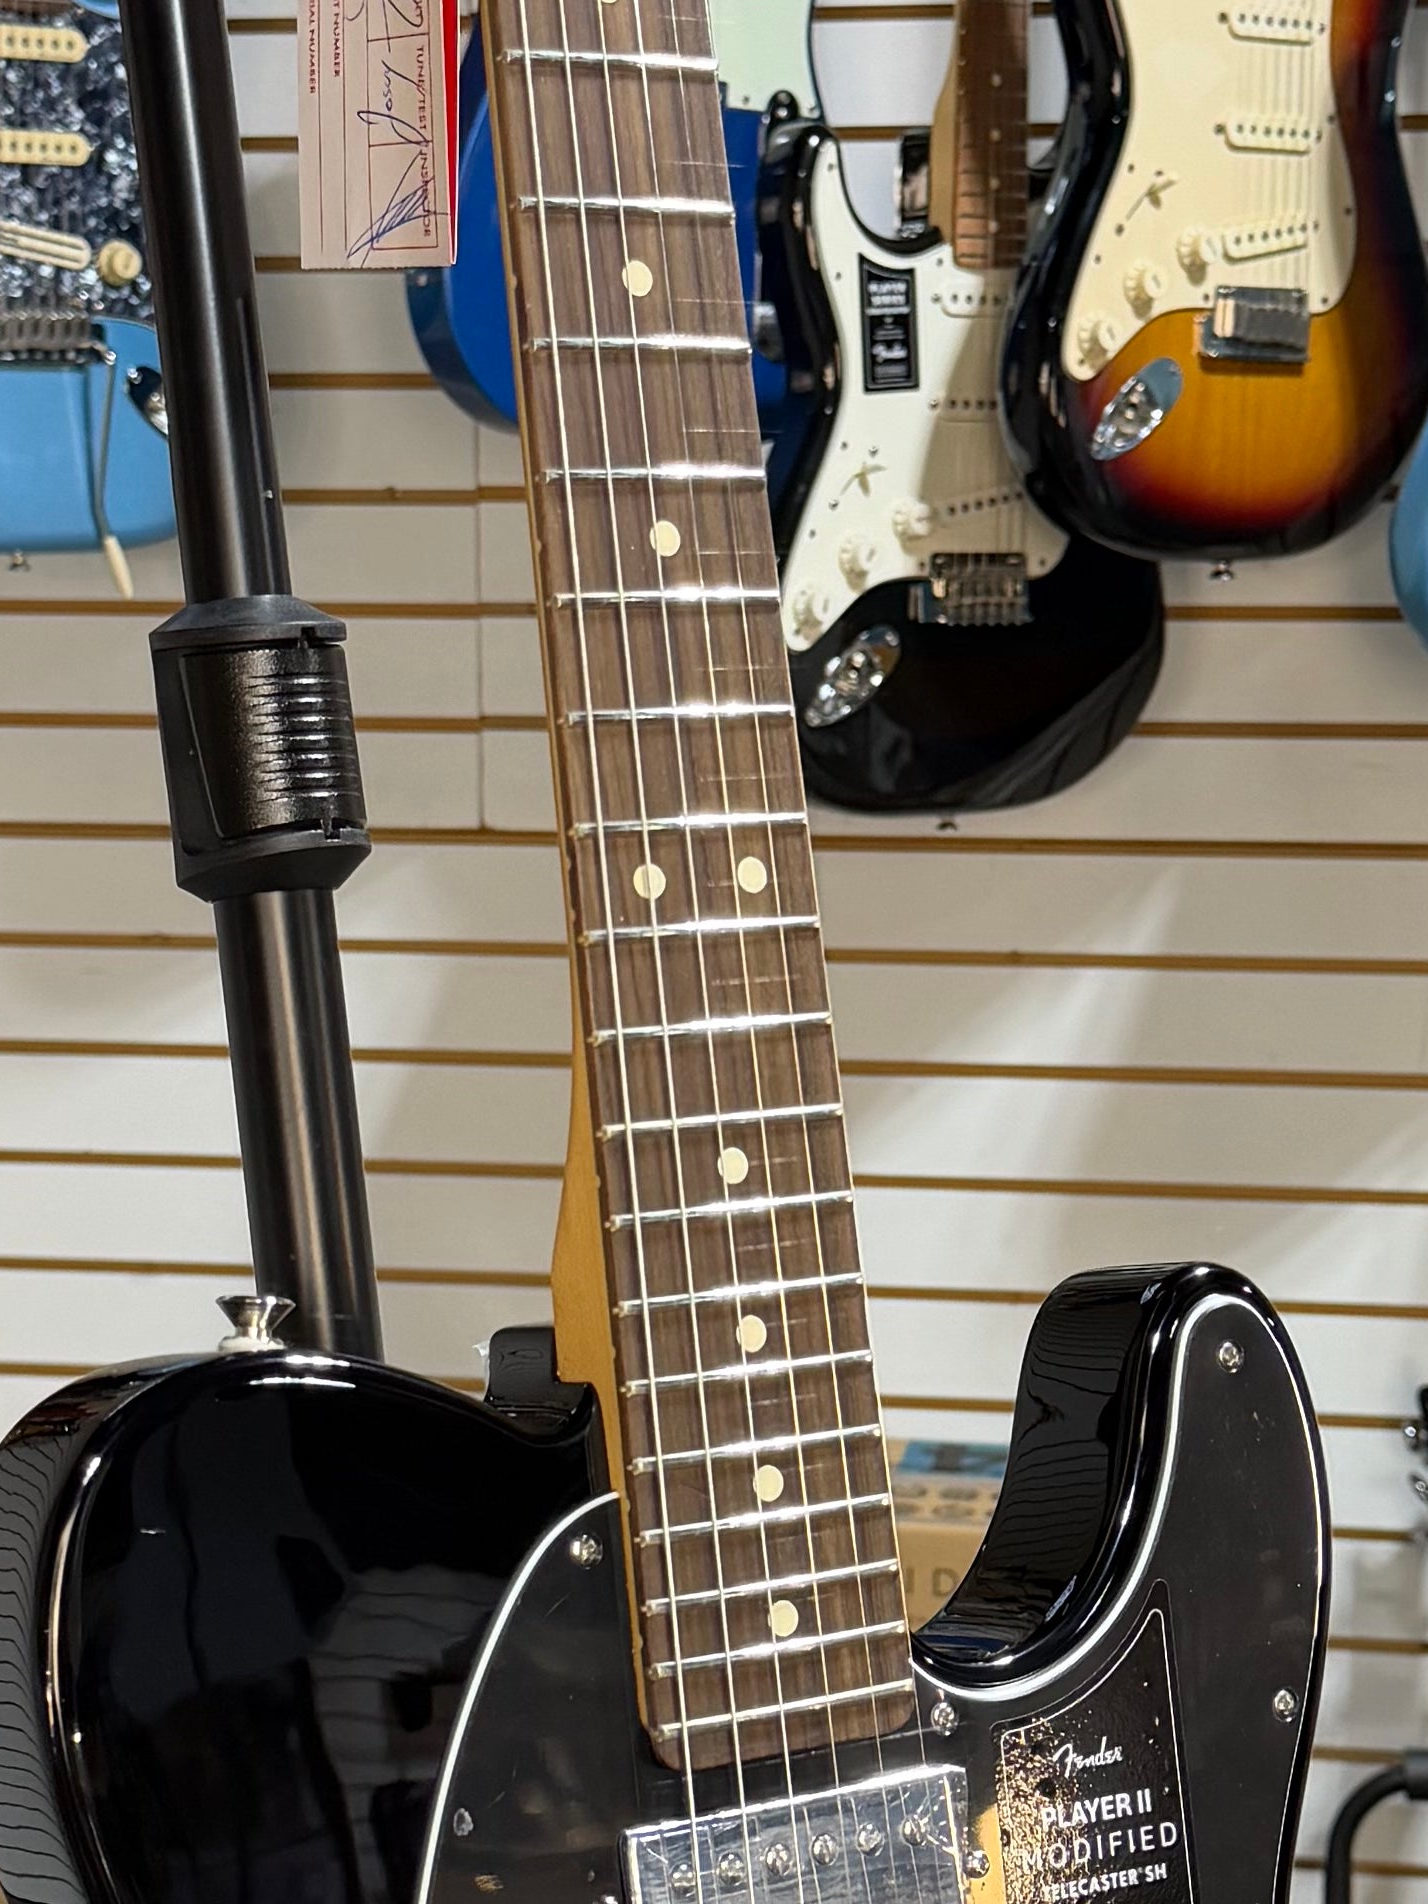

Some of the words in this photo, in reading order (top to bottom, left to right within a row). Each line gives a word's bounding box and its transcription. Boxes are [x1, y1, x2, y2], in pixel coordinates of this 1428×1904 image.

[1052, 1736, 1123, 1779] Fender
[1040, 1793, 1134, 1833] PLAYER
[1137, 1788, 1153, 1814] II
[1022, 1821, 1178, 1875] MODIFIED
[1144, 1862, 1168, 1883] SH
